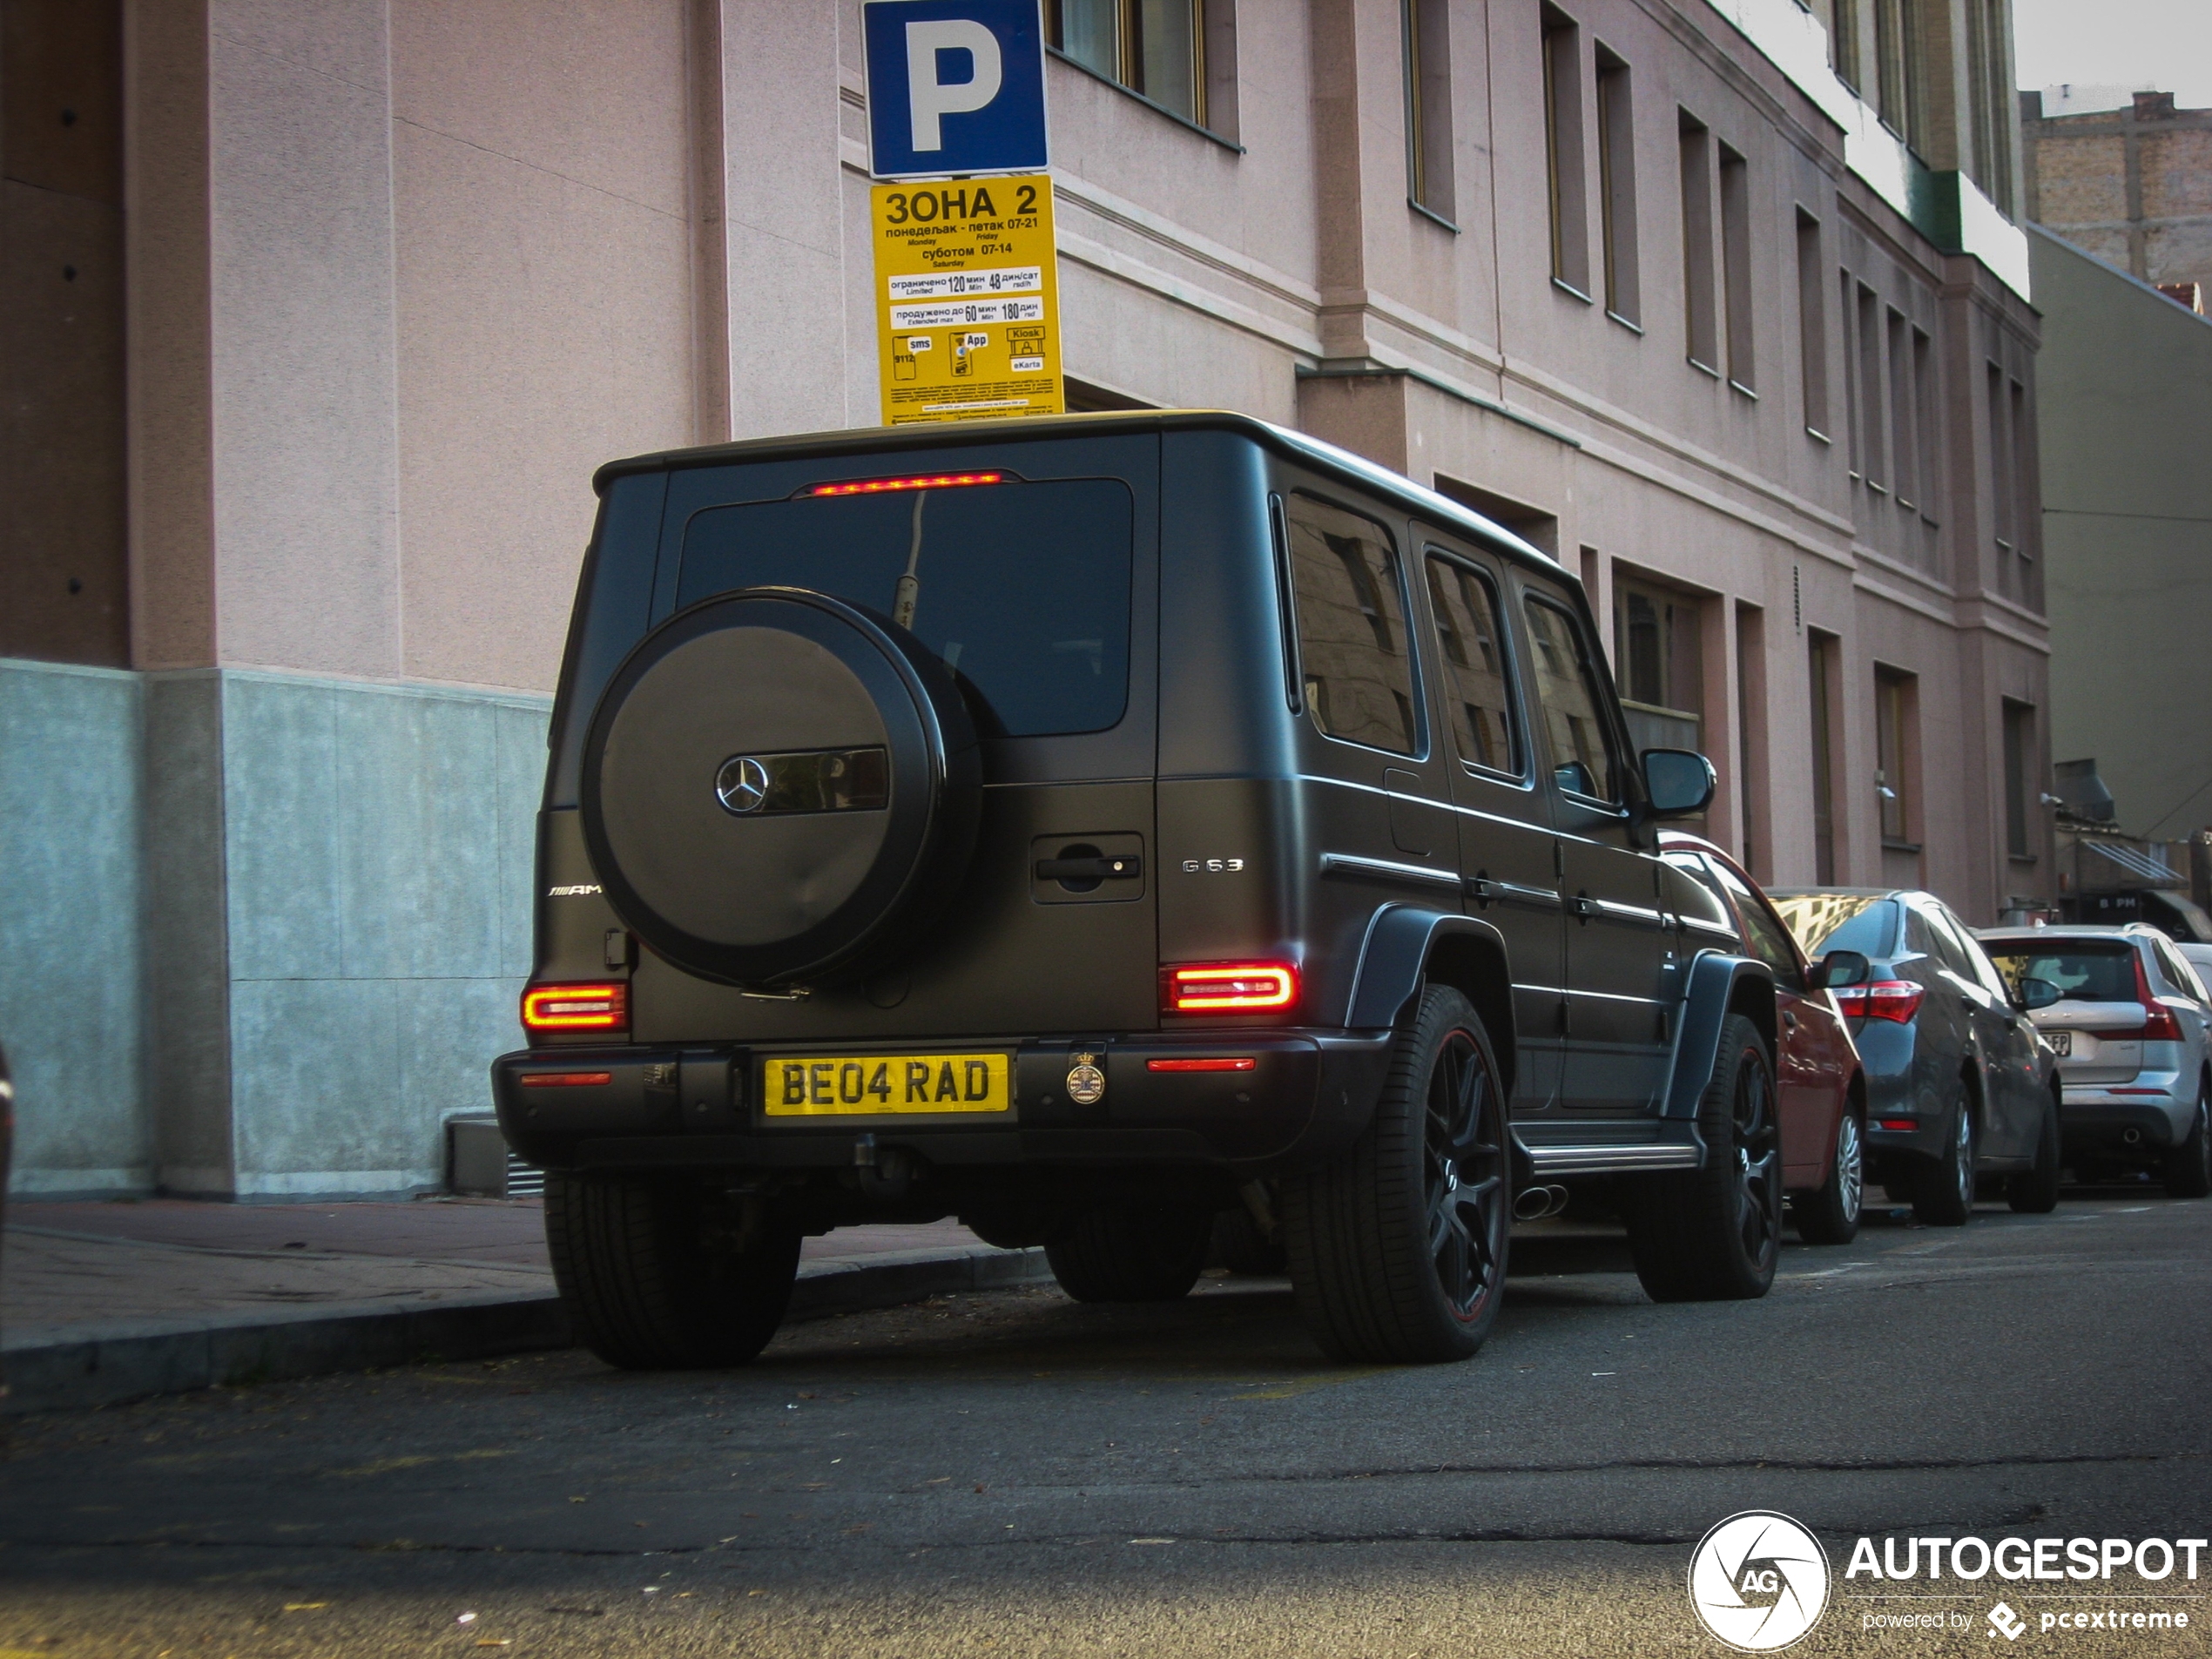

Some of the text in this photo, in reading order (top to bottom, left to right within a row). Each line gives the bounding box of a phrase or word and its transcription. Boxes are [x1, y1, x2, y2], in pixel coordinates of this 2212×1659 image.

[906, 19, 1002, 152] P
[886, 185, 1037, 224] ЗОНА 2
[886, 225, 957, 238] понедељак
[968, 222, 1004, 233] петак
[1008, 217, 1037, 229] 07-21
[922, 242, 1012, 260] суботом 07-14
[891, 279, 947, 289] ограничено
[948, 275, 965, 293] 120
[989, 273, 1001, 290] 48
[1001, 272, 1038, 282] дин/сат
[896, 308, 950, 320] продужено
[965, 305, 977, 322] 60
[1001, 302, 1019, 320] 180
[968, 335, 987, 347] App
[1013, 329, 1040, 338] Kiosk
[910, 340, 930, 349] sms
[894, 354, 915, 363] 9112
[1183, 859, 1244, 872] G 63
[906, 1061, 989, 1103] RAD
